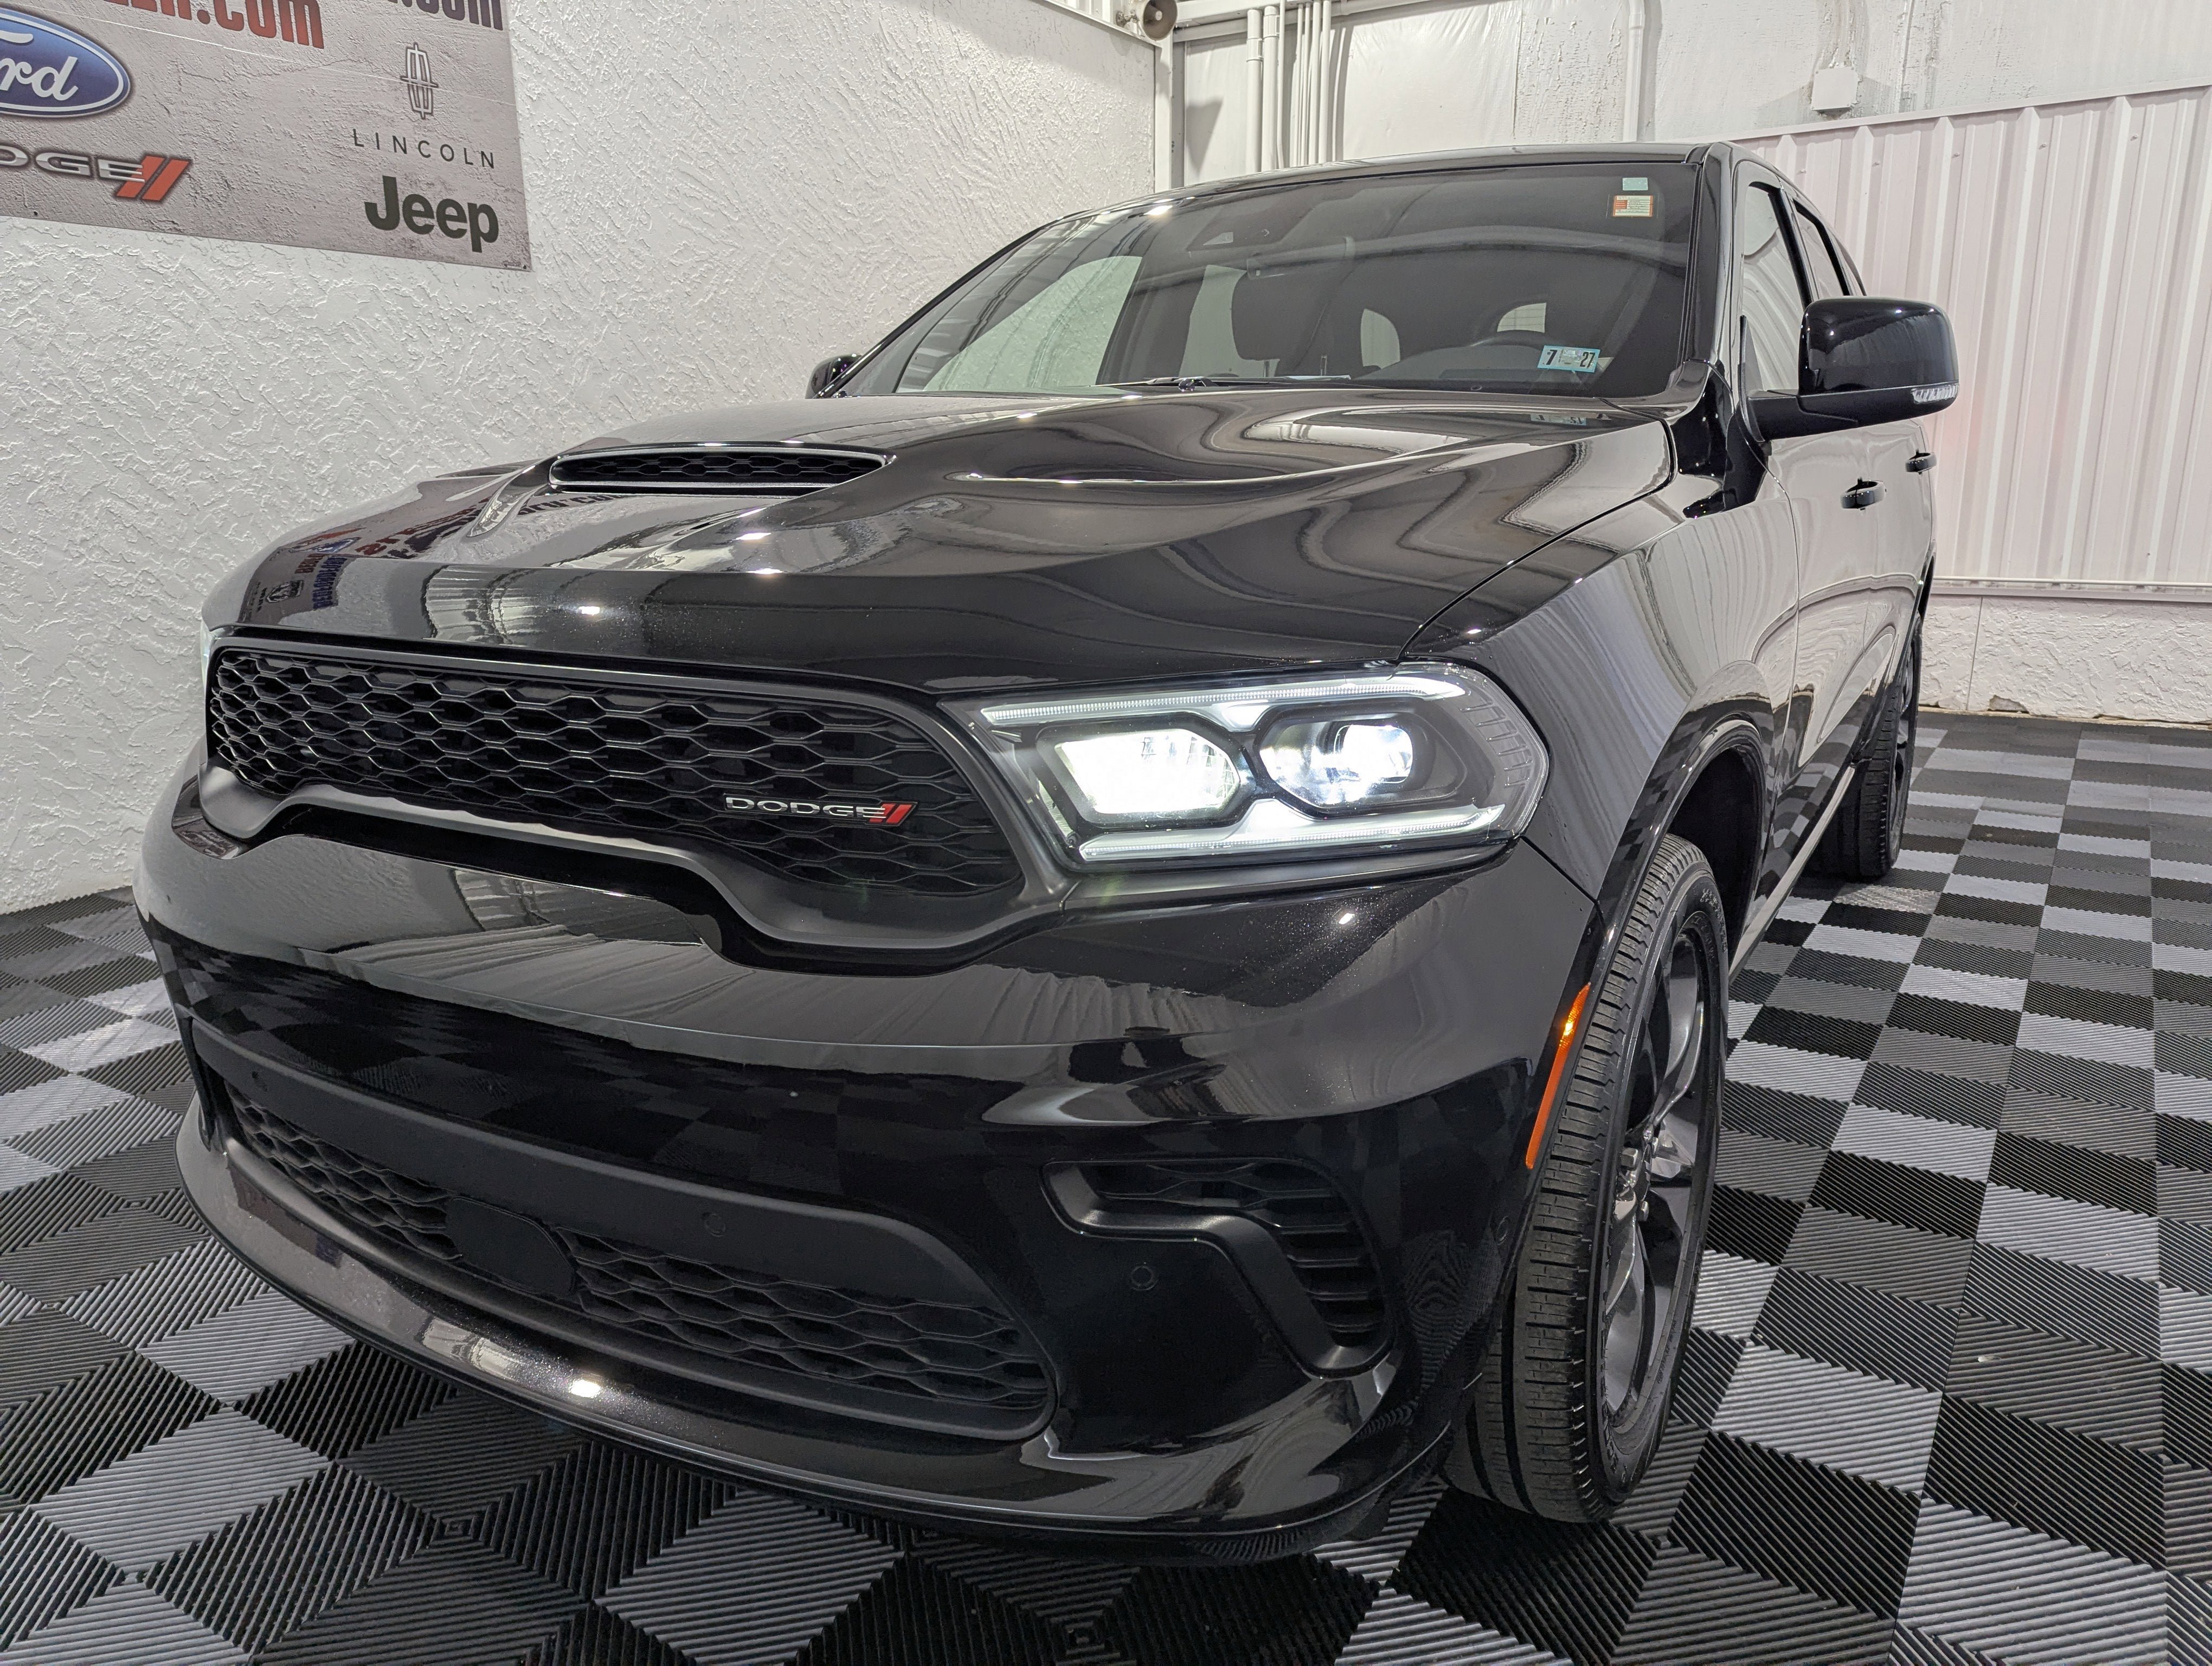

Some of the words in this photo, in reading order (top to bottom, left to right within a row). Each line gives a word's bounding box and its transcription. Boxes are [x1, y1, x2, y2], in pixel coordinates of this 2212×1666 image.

[352, 129, 494, 169] LINCOLN
[364, 175, 499, 253] Jeep
[1546, 349, 1558, 366] 7
[1579, 351, 1596, 369] 27
[725, 797, 886, 818] DODGE
